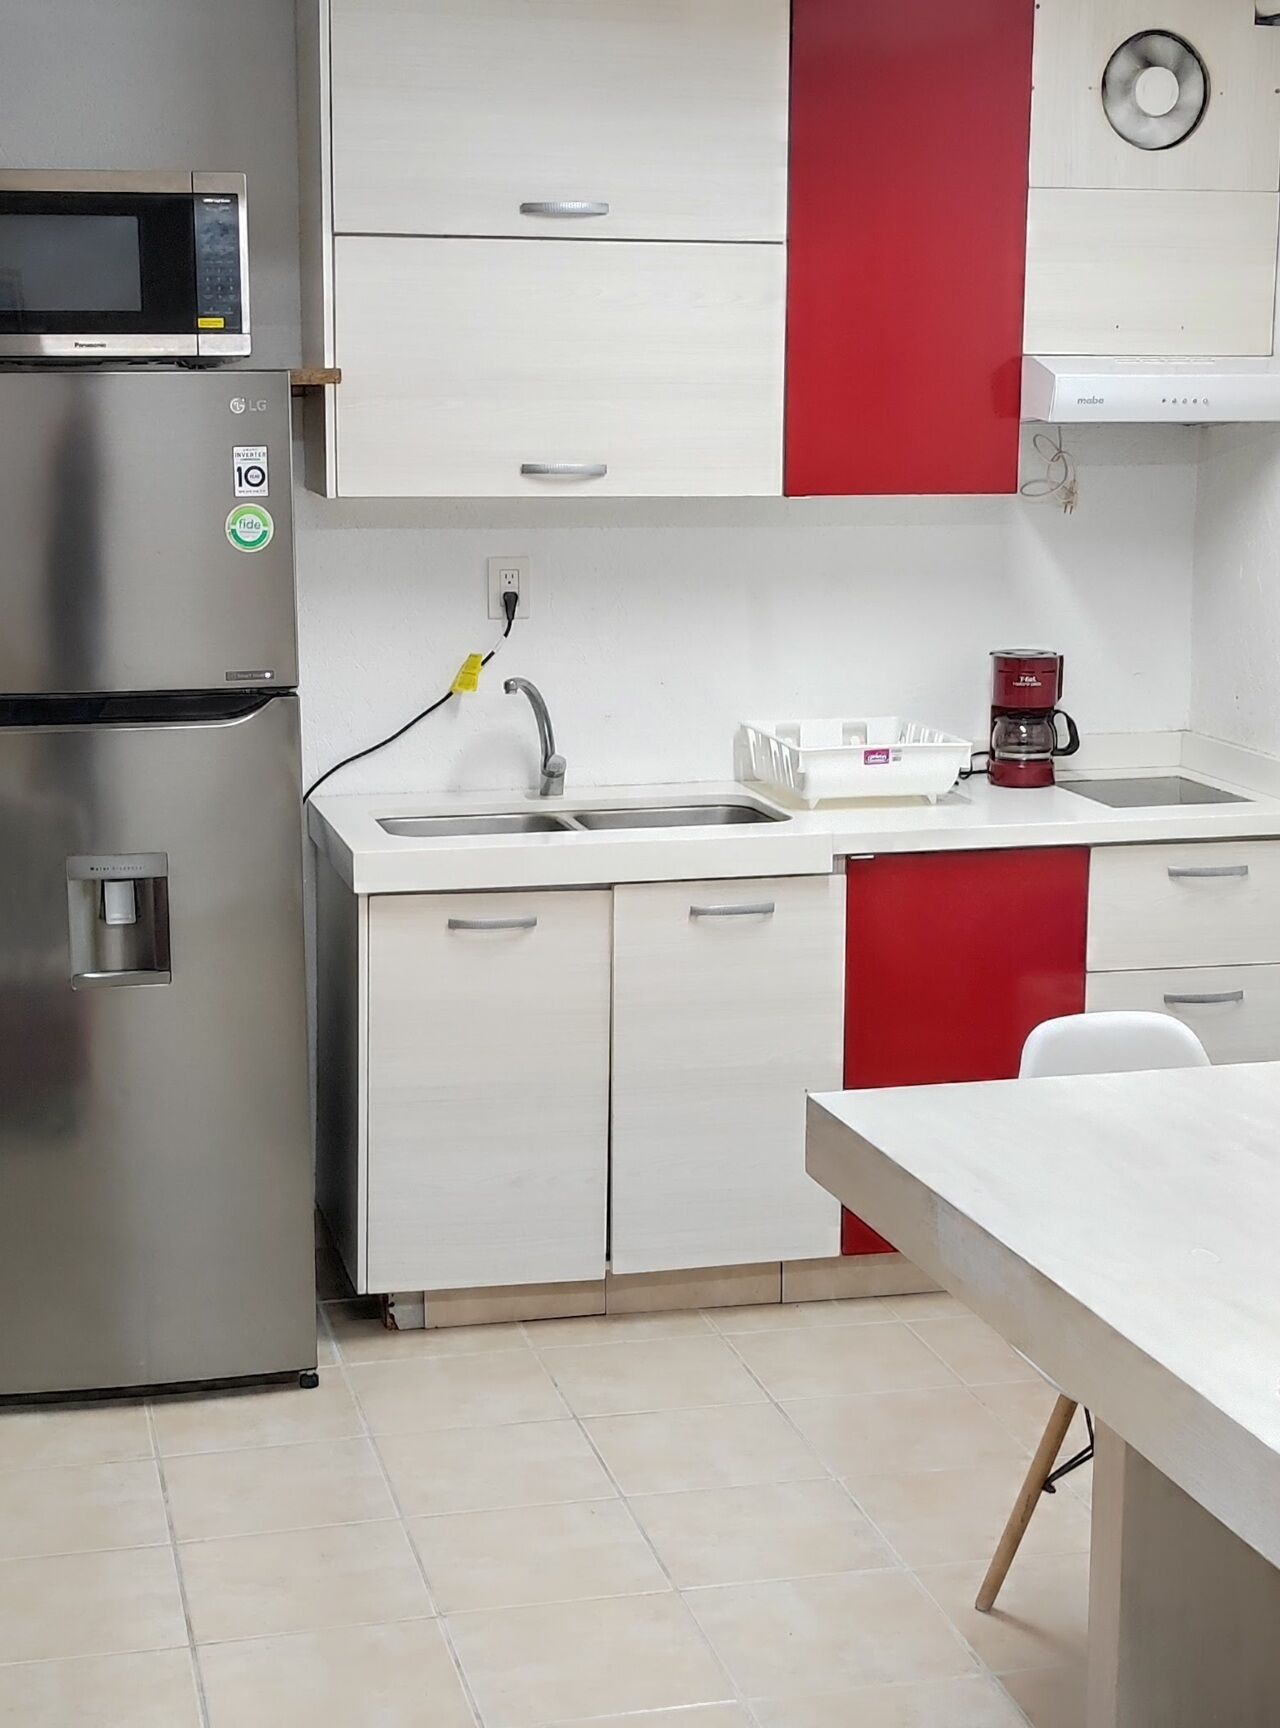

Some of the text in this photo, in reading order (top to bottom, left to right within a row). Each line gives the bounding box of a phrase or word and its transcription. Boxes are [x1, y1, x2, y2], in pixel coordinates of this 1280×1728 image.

[74, 341, 107, 349] Panasonic
[249, 399, 267, 411] LG
[236, 465, 266, 488] 10
[239, 518, 261, 530] fide
